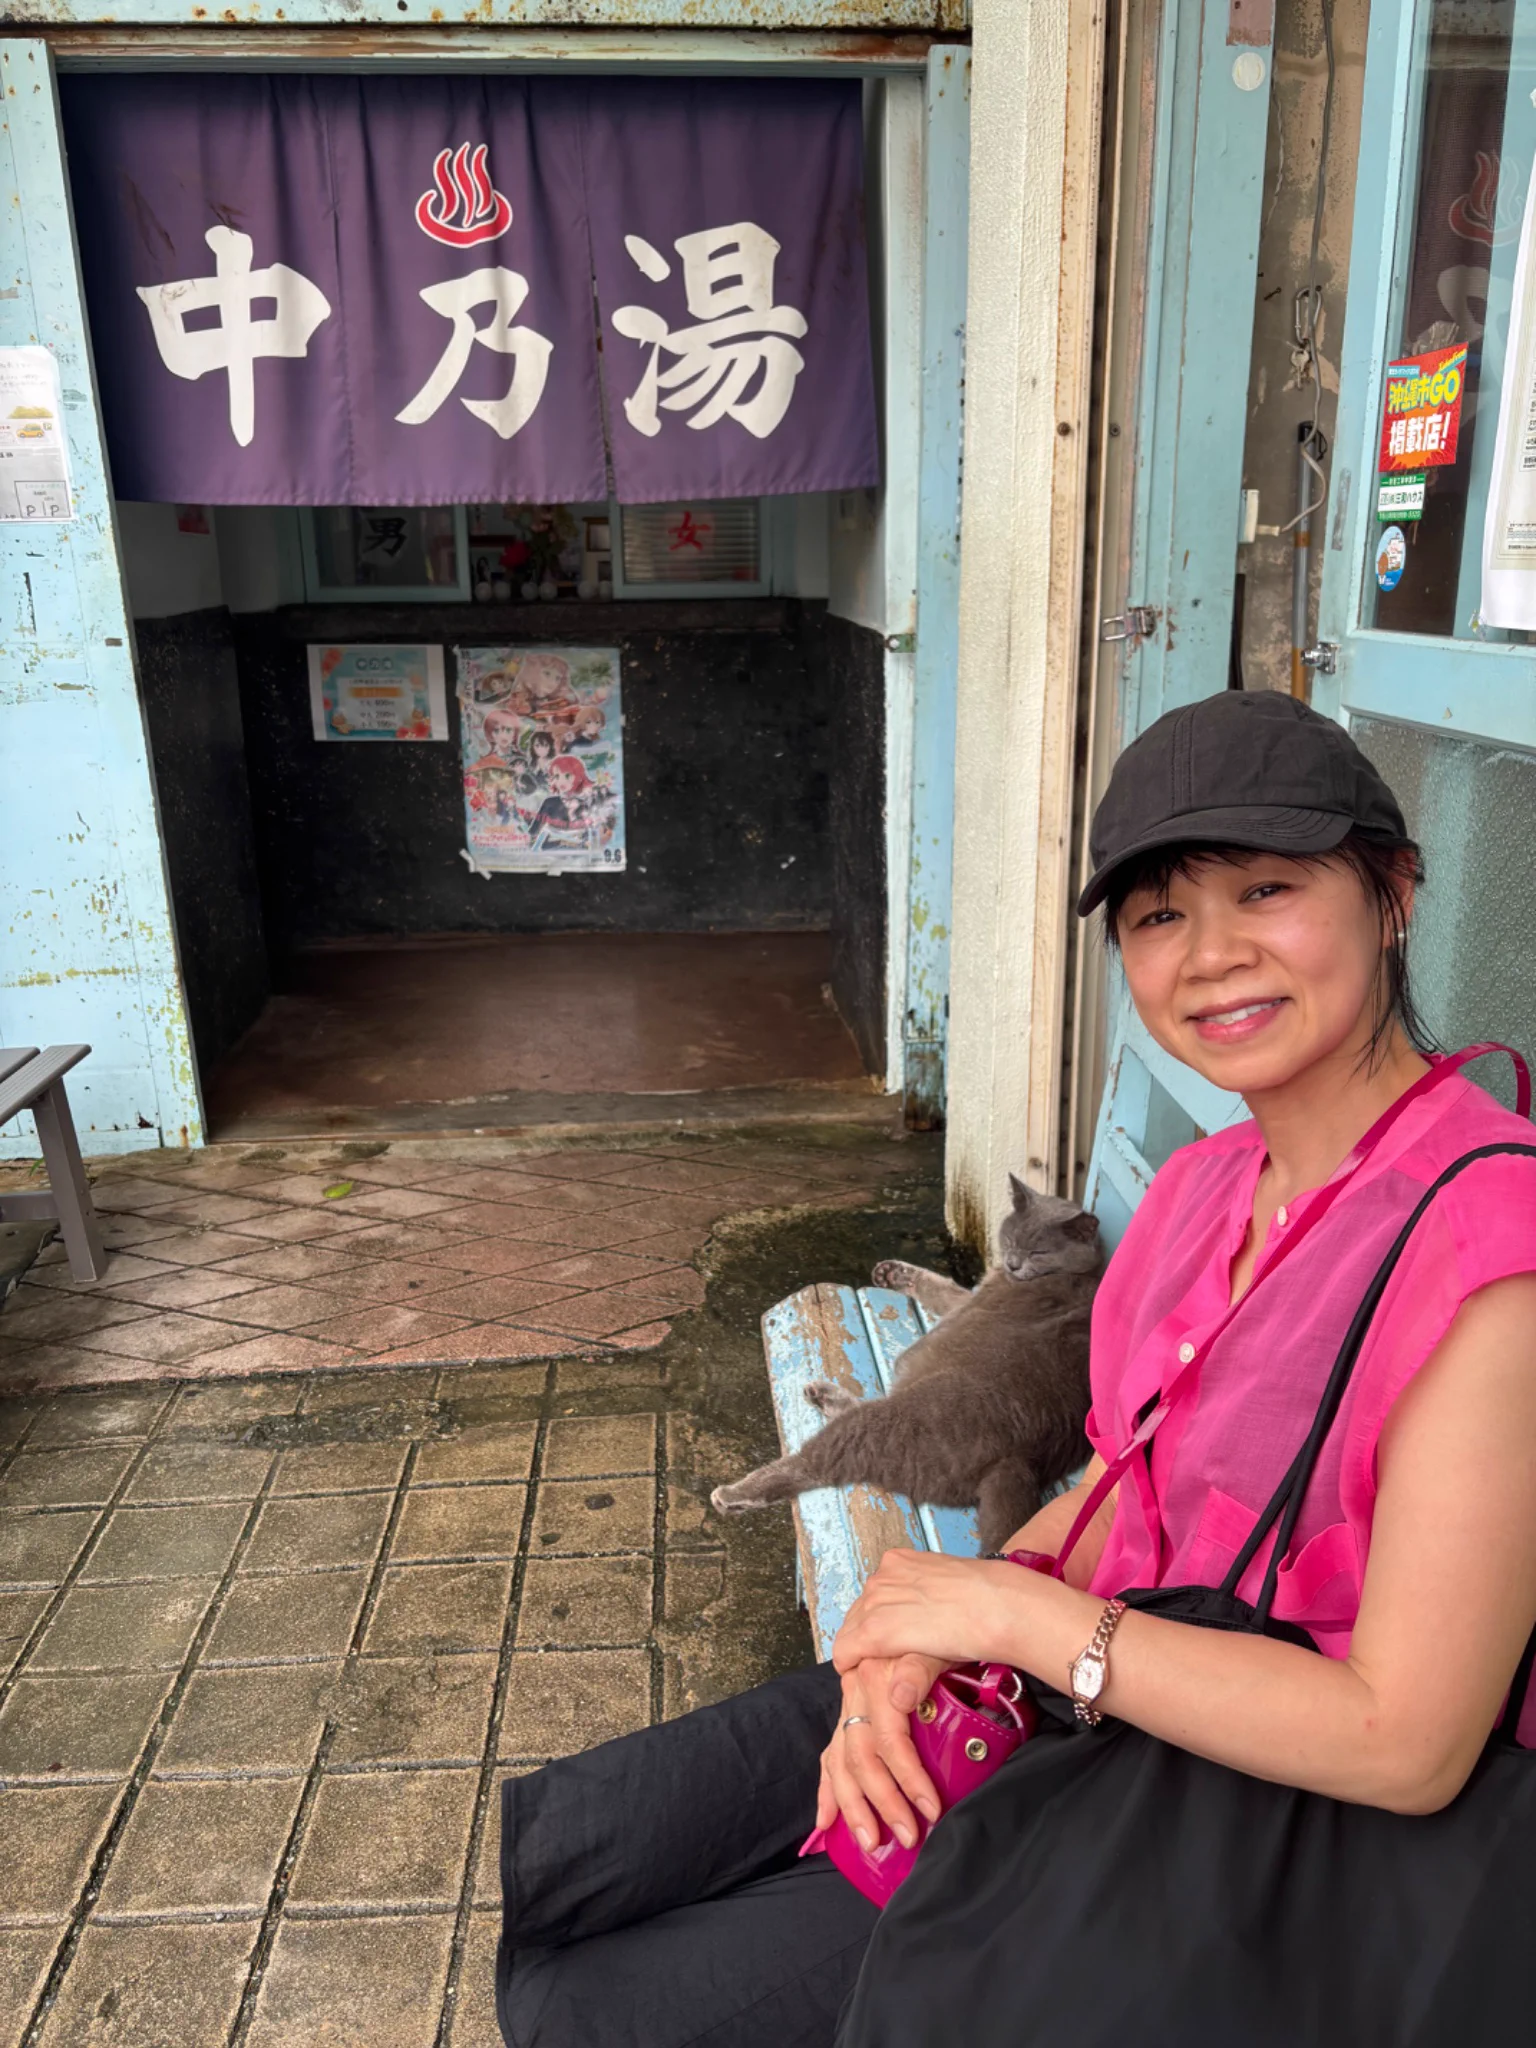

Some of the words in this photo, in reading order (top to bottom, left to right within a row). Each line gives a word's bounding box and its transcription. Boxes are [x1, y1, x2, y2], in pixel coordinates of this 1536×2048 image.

[135, 222, 808, 446] 中乃湯
[361, 517, 408, 557] 男
[668, 511, 711, 551] 女
